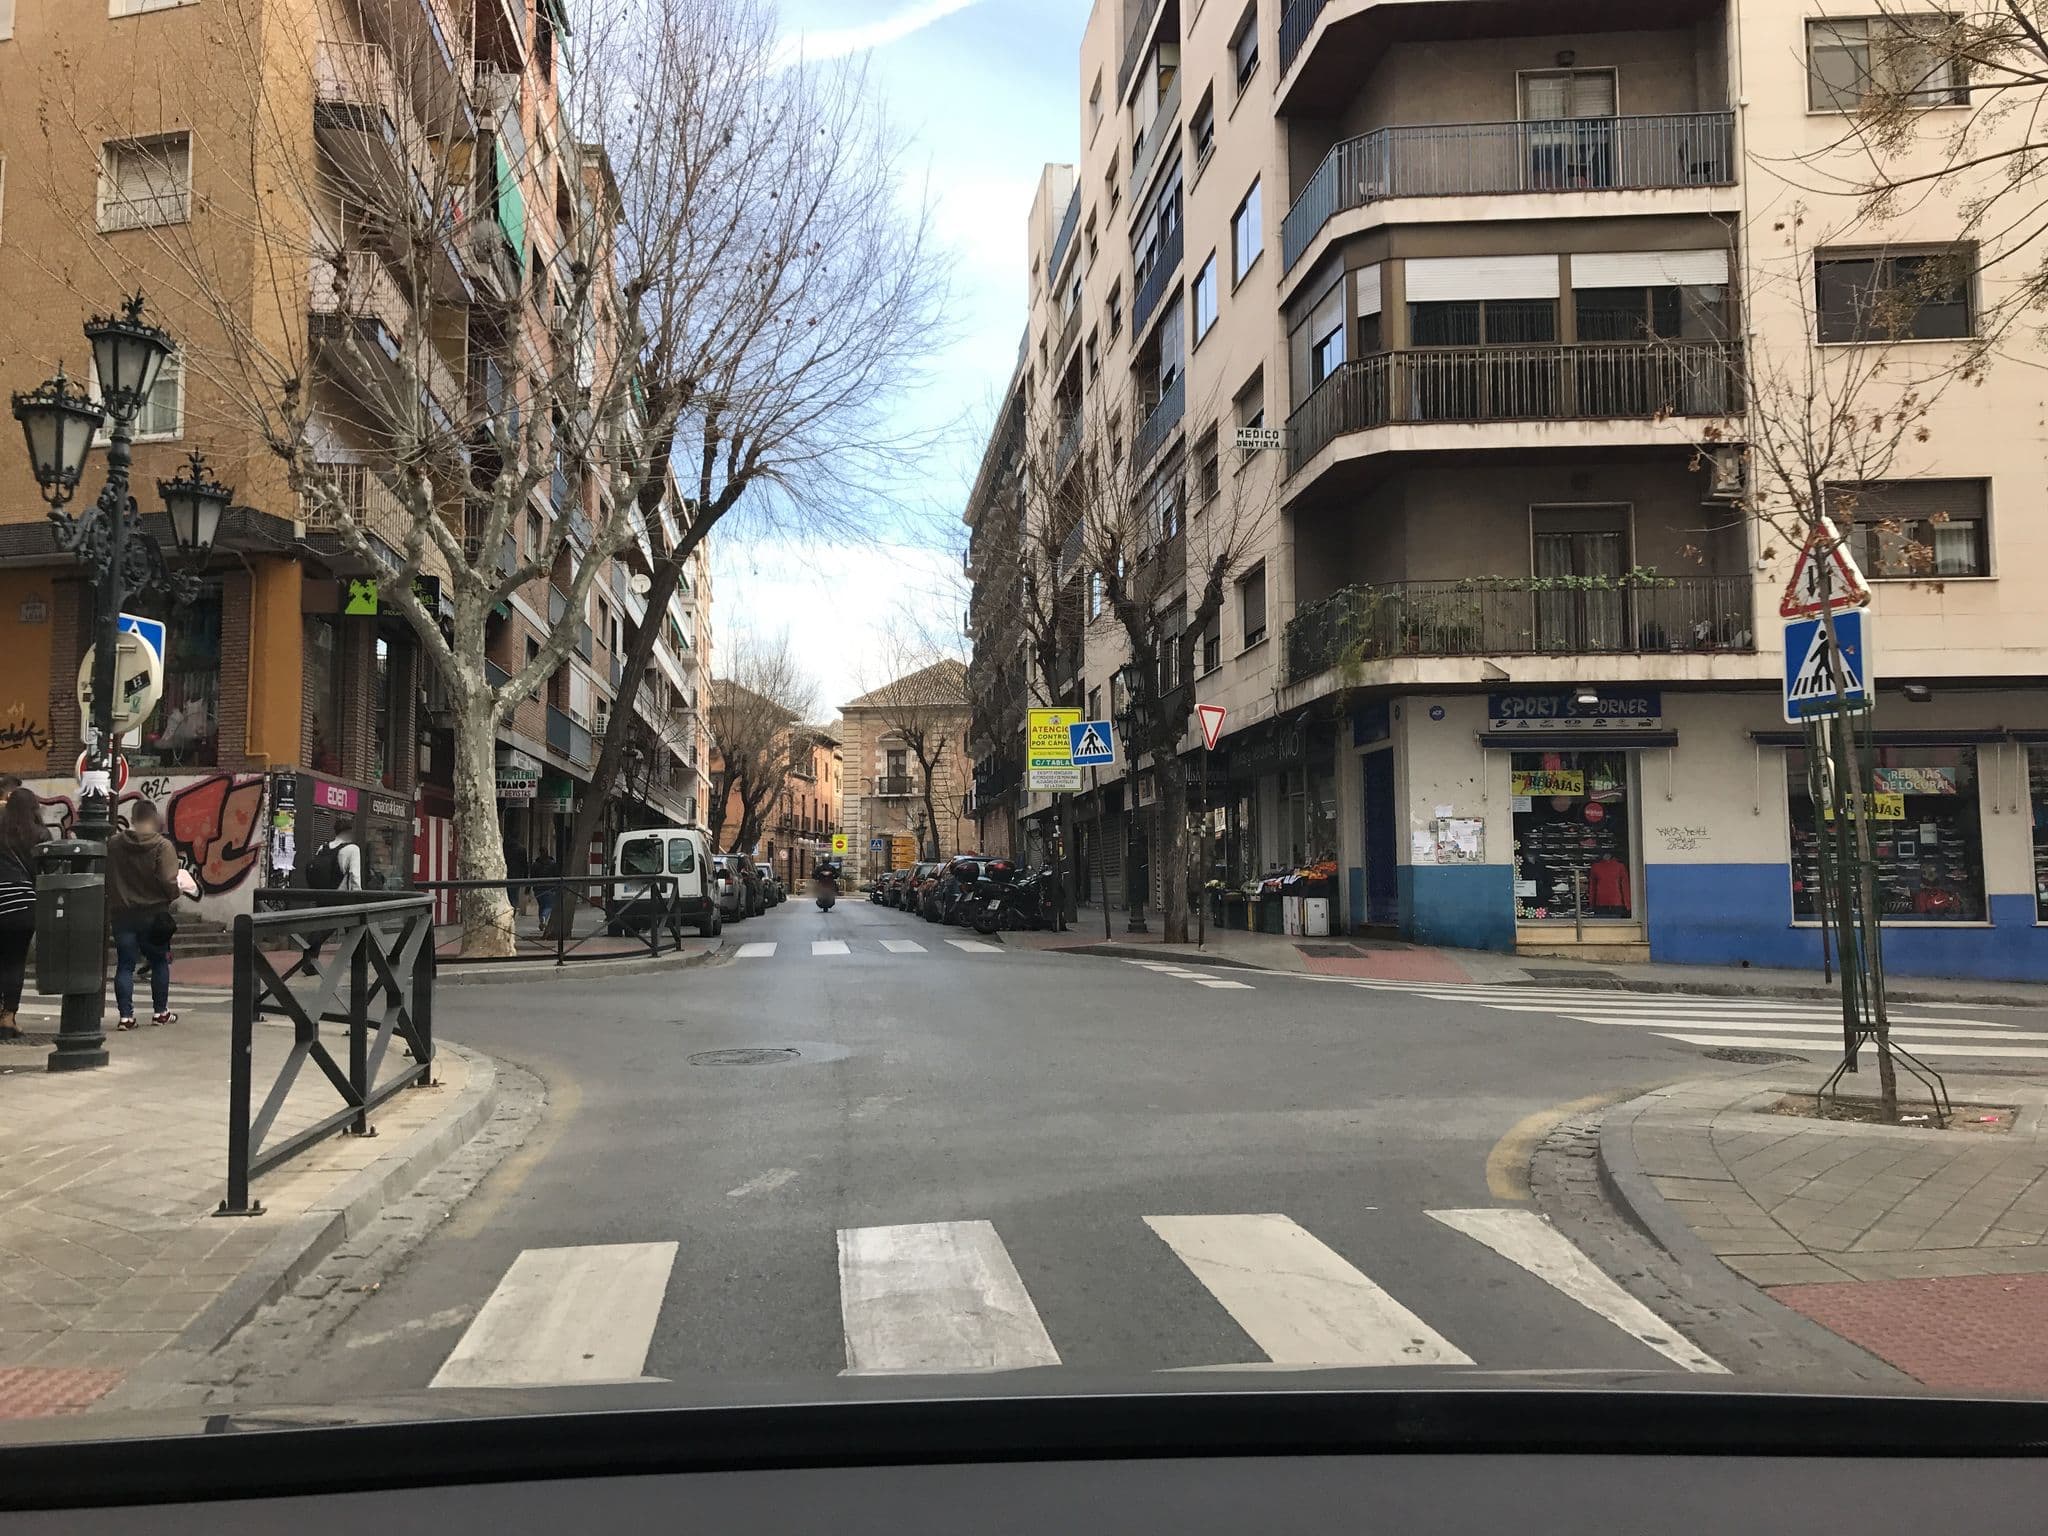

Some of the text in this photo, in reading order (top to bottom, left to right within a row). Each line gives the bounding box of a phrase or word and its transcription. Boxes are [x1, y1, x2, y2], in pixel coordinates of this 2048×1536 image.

[1237, 430, 1279, 439] MEDICO
[1236, 440, 1280, 448] DENTISTA
[1590, 699, 1648, 714] ORNER
